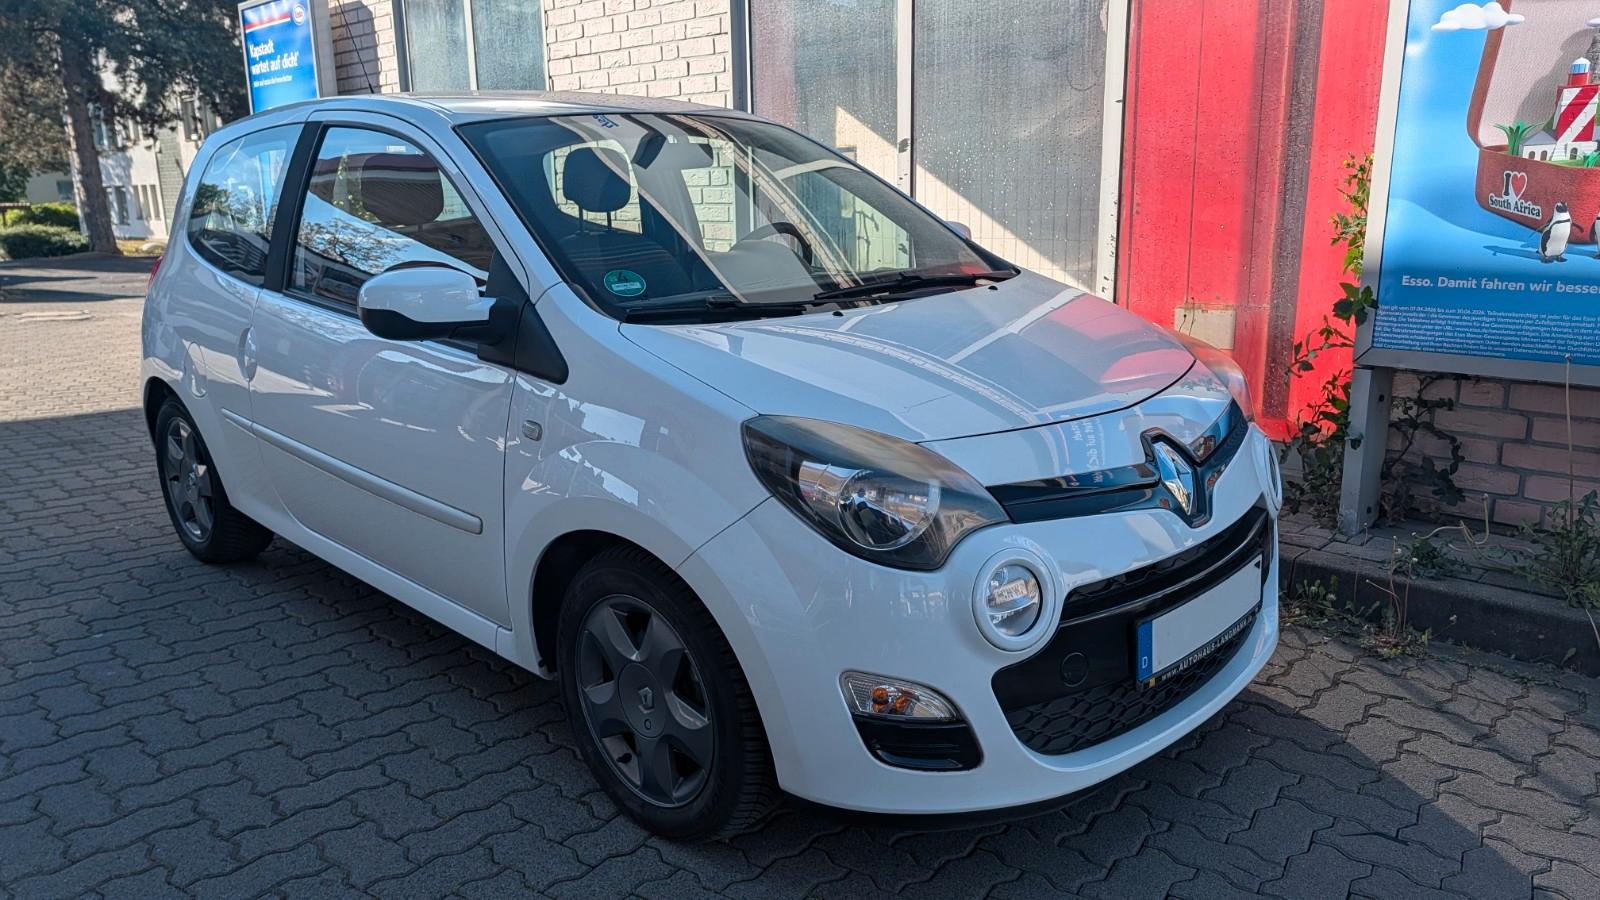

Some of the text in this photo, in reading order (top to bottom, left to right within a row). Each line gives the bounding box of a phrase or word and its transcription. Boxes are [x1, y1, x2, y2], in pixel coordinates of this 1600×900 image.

[250, 39, 275, 61] Kapstadt
[251, 60, 269, 75] wartet
[270, 55, 280, 70] auf
[1503, 172, 1511, 196] I
[1489, 196, 1541, 218] South Africa
[1402, 275, 1433, 287] Esso.
[1437, 276, 1477, 289] Damit
[1481, 278, 1525, 291] fahren
[1529, 280, 1553, 292] wir
[1142, 656, 1149, 669] D
